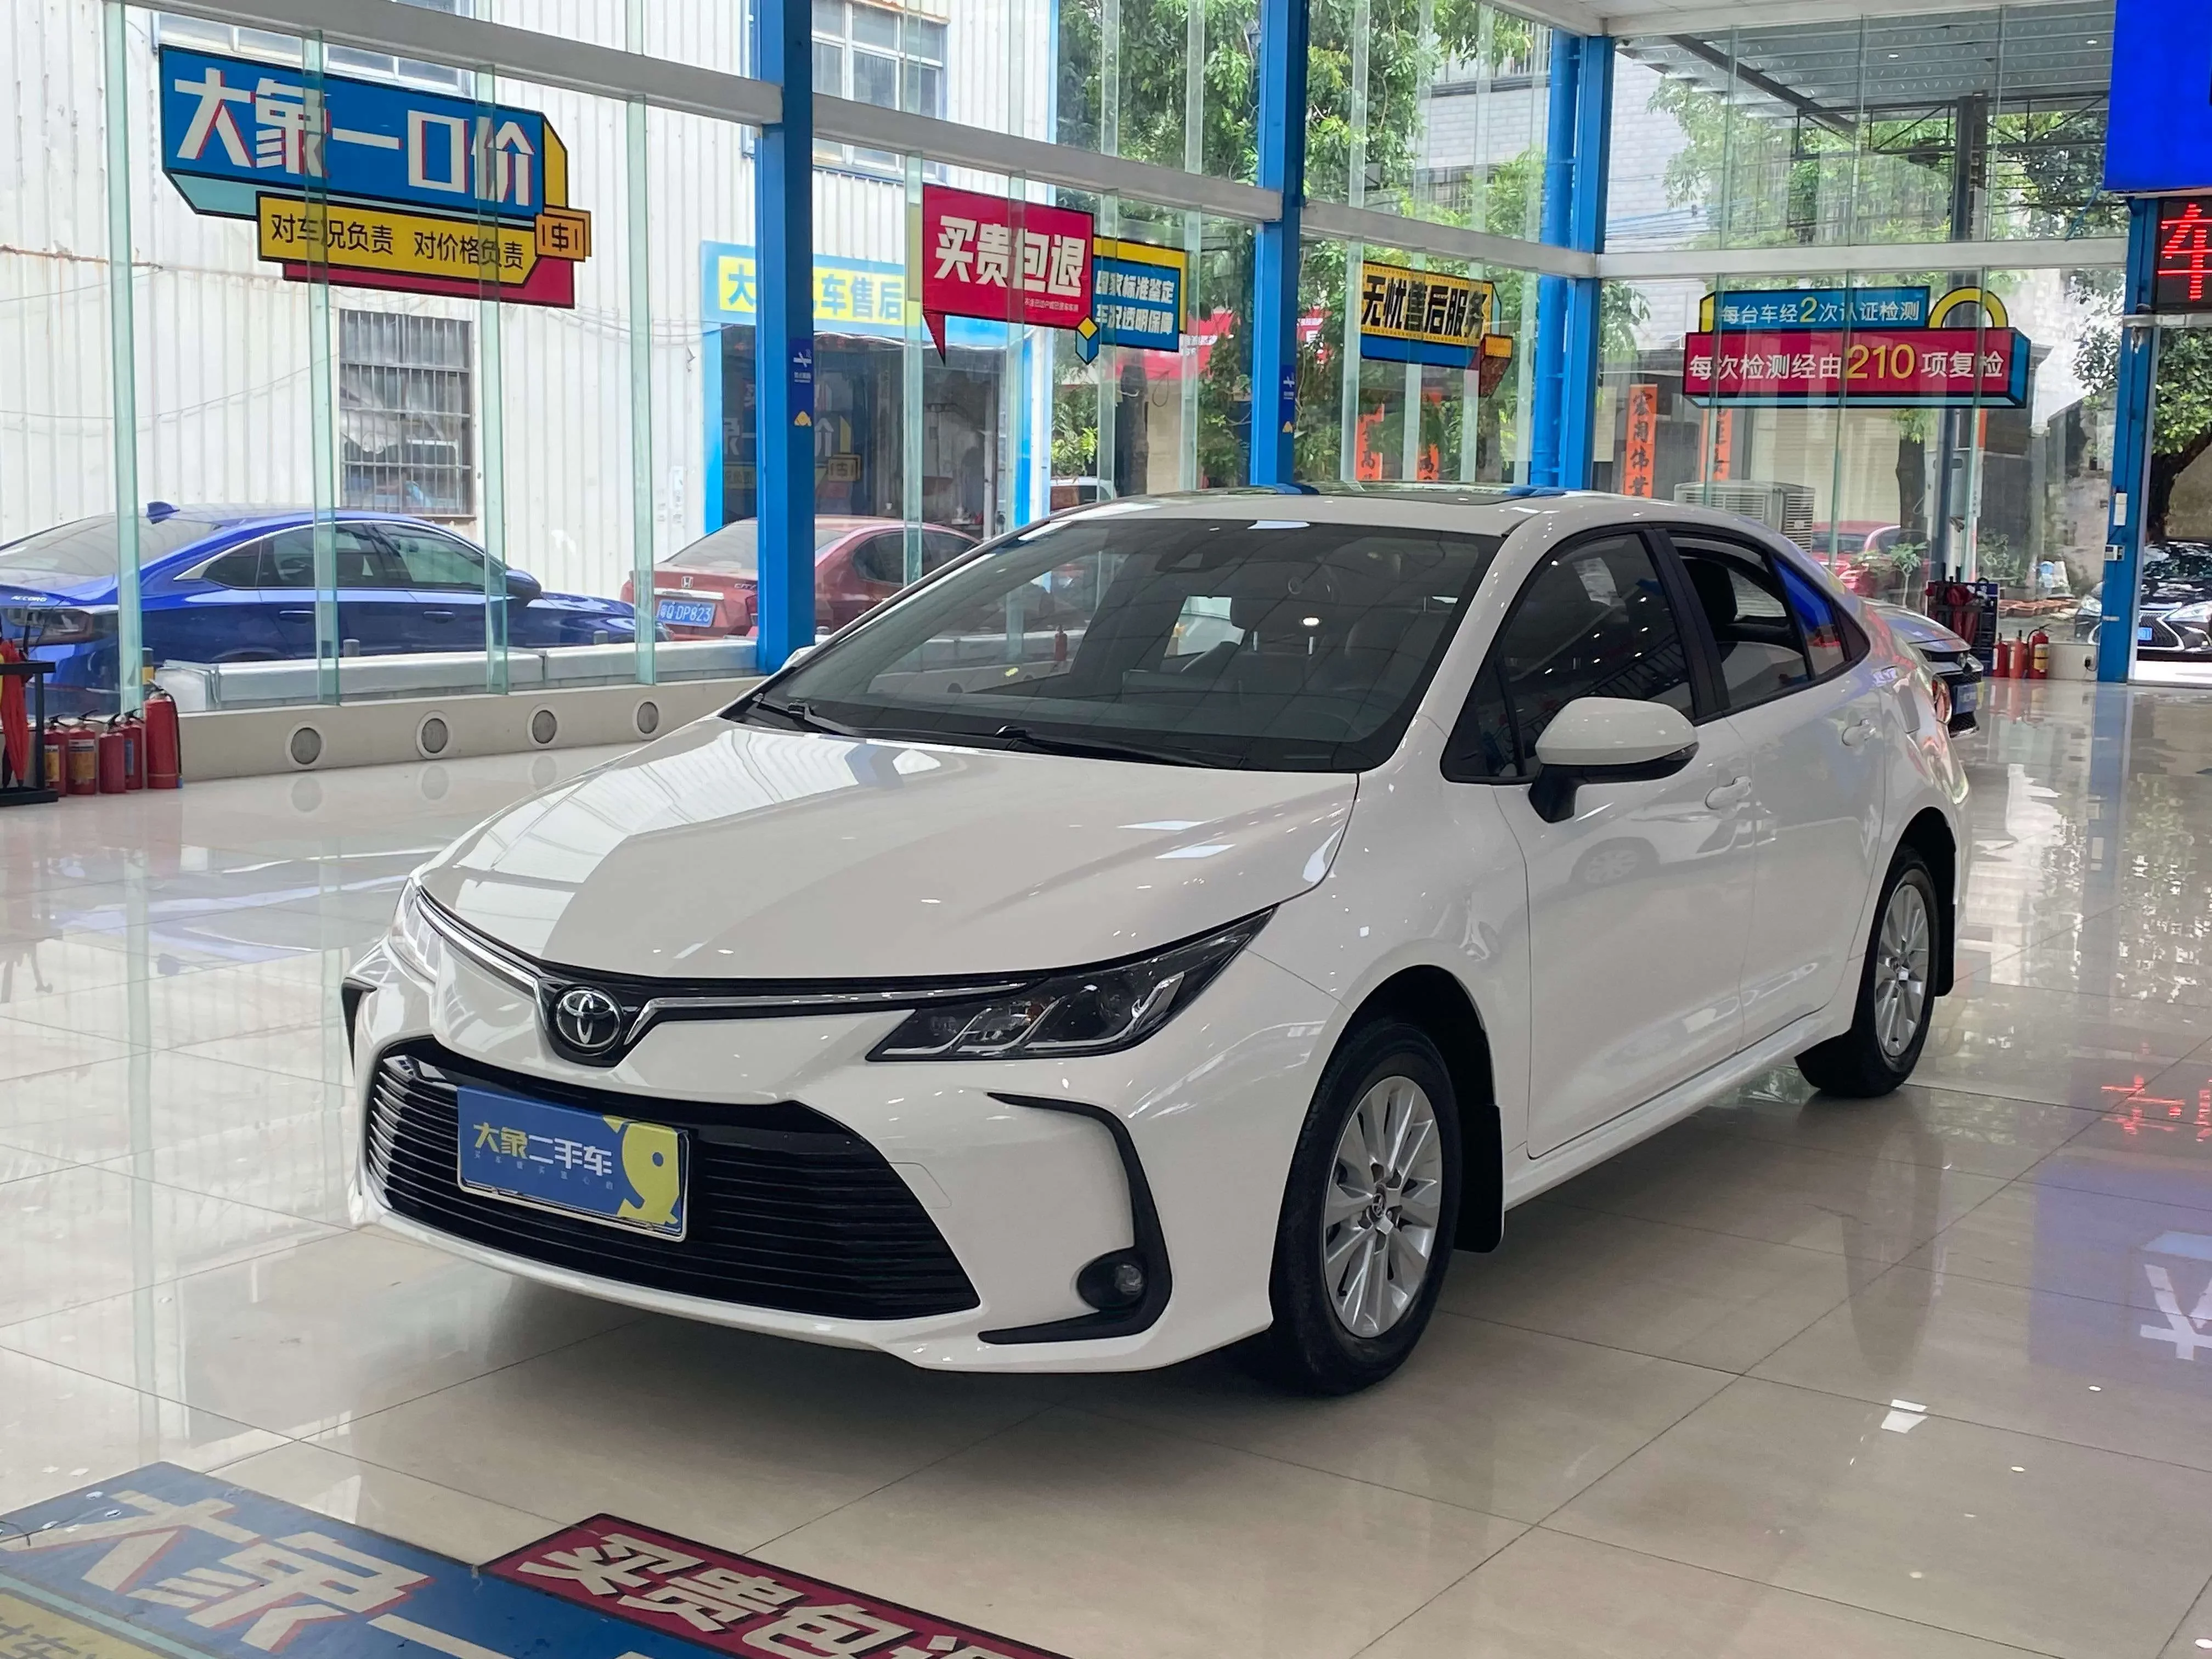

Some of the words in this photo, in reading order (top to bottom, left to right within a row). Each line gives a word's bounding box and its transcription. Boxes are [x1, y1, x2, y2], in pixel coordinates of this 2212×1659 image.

[174, 66, 535, 207] 大象一口价
[414, 230, 524, 270] 对价格负责
[934, 215, 1086, 297] 买贵包退
[1361, 274, 1488, 338] 无忧售后服务
[473, 1121, 613, 1177] 大象二手车
